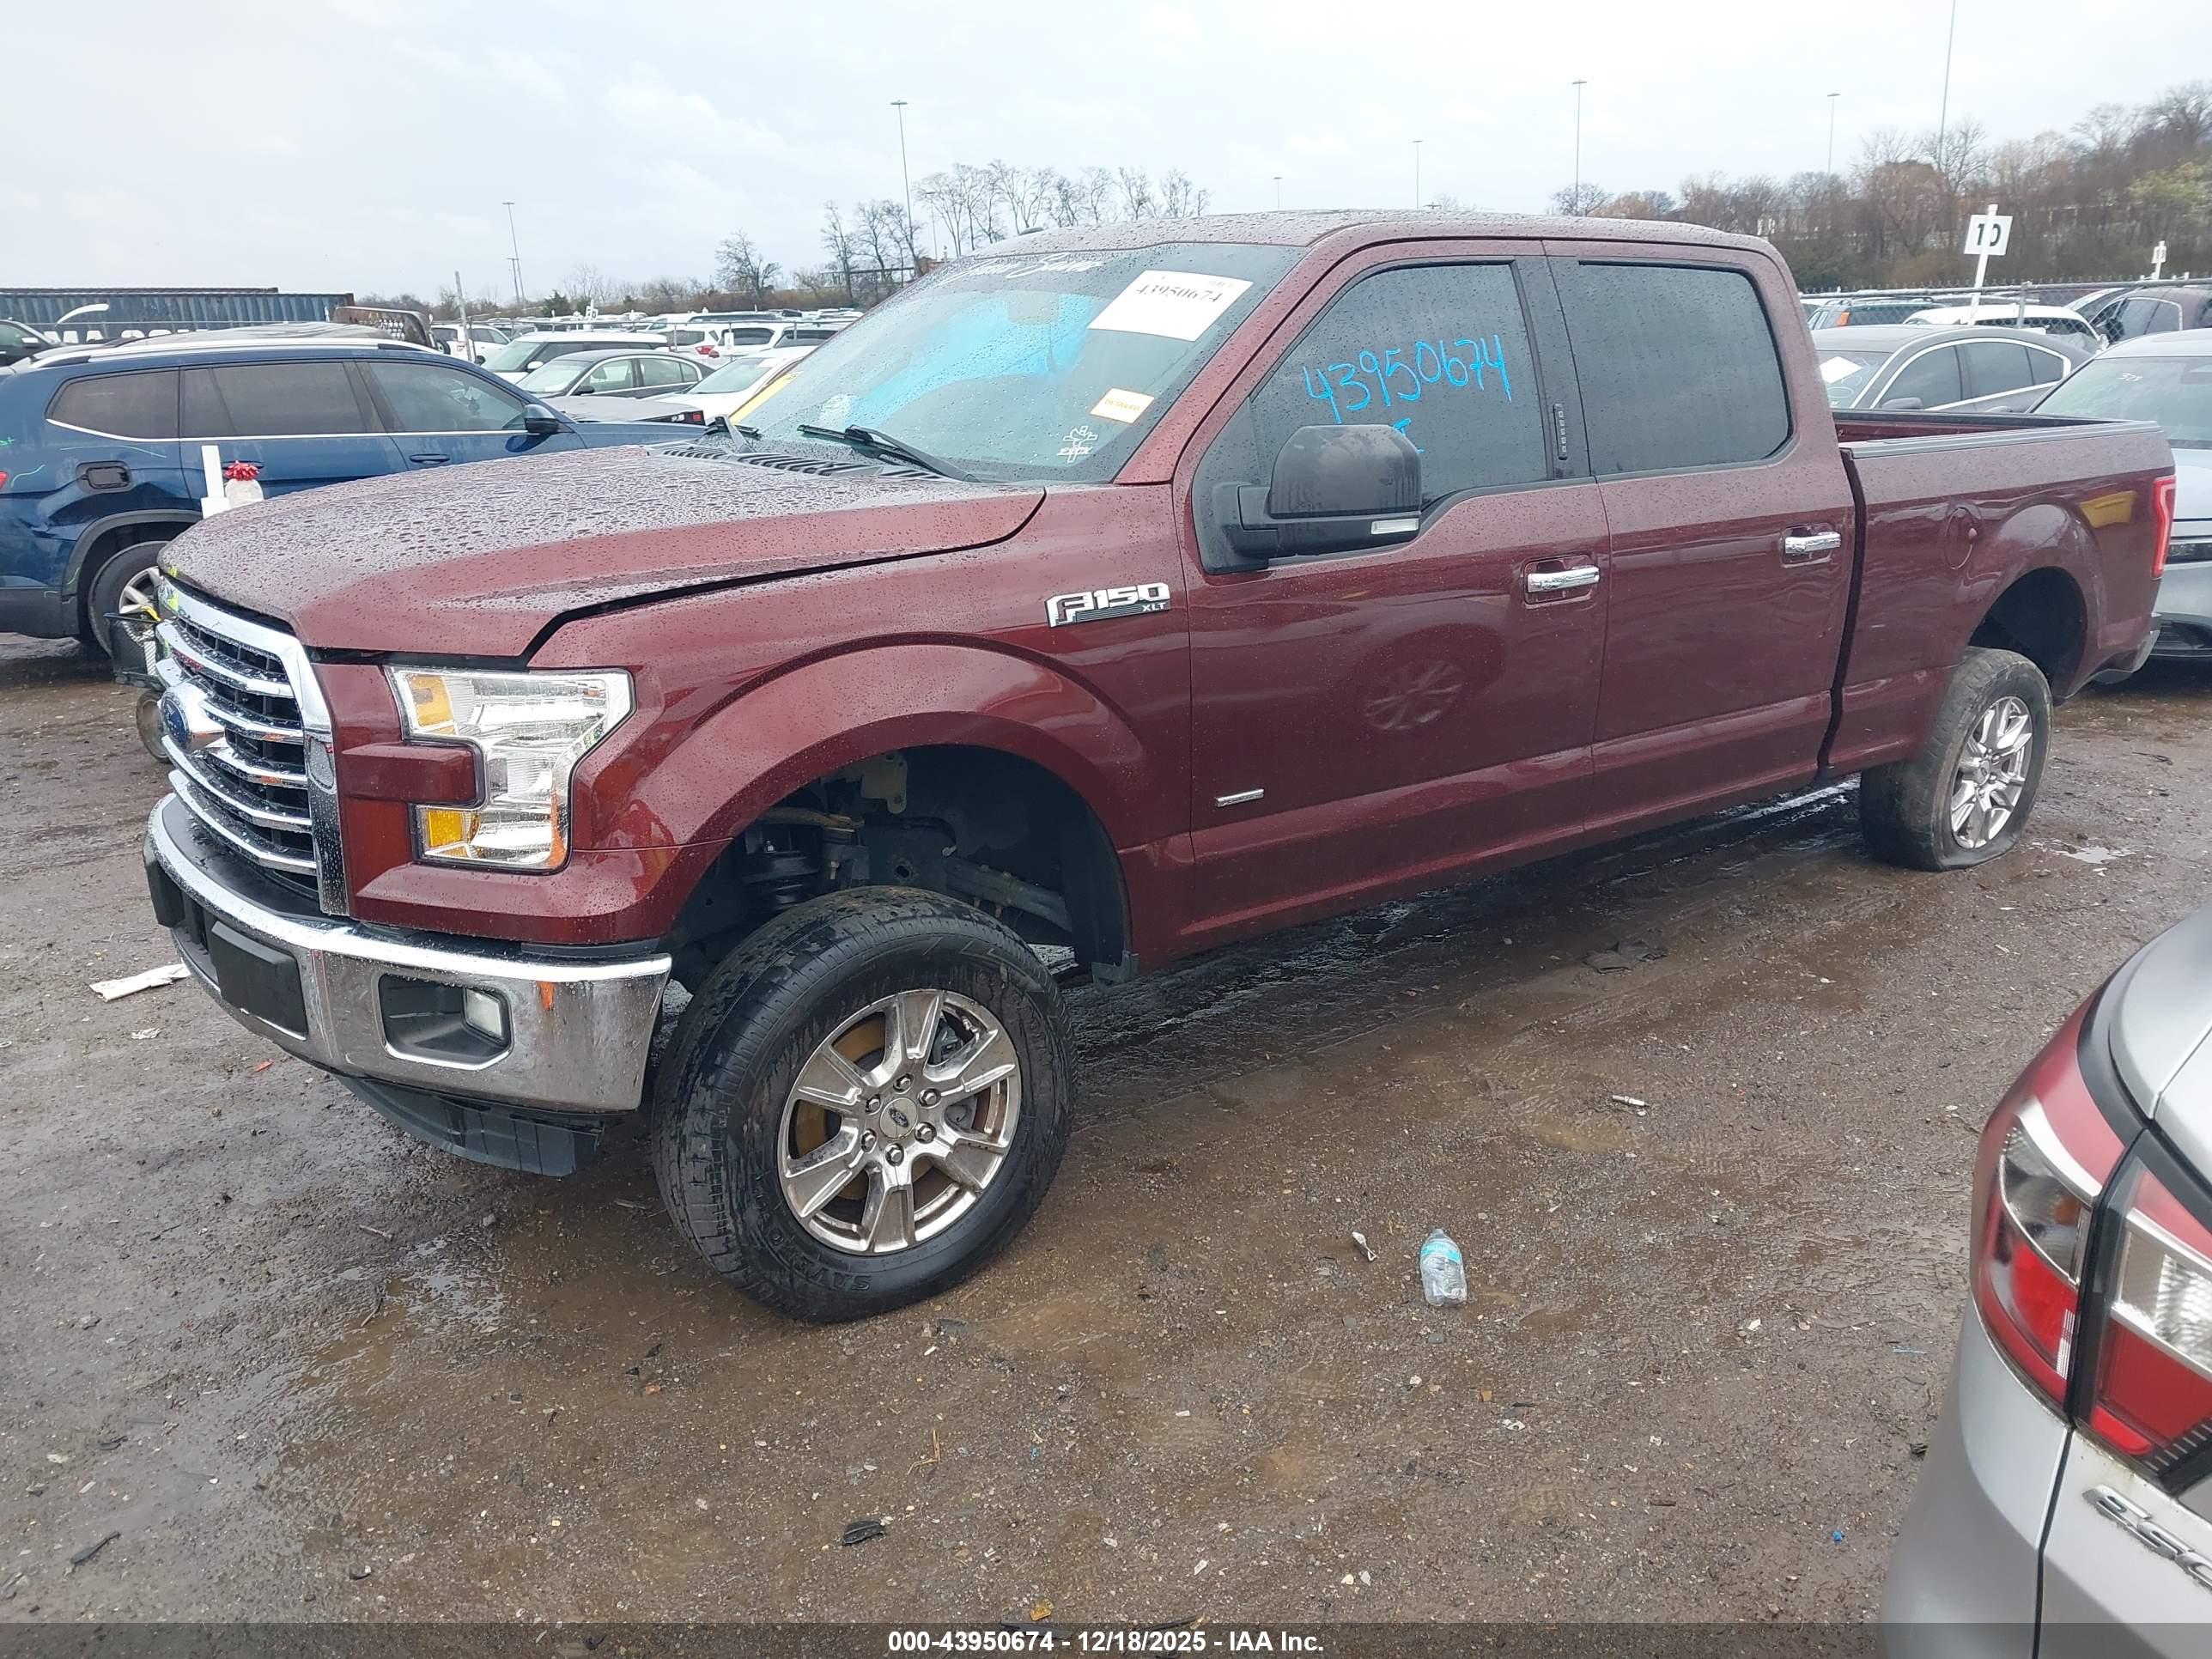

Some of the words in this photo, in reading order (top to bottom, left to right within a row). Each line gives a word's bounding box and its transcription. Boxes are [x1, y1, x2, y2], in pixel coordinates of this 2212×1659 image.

[1977, 223, 2002, 247] 10
[1135, 284, 1224, 302] 43950674
[1302, 334, 1512, 424] 43950674
[1142, 602, 1167, 612] XLT
